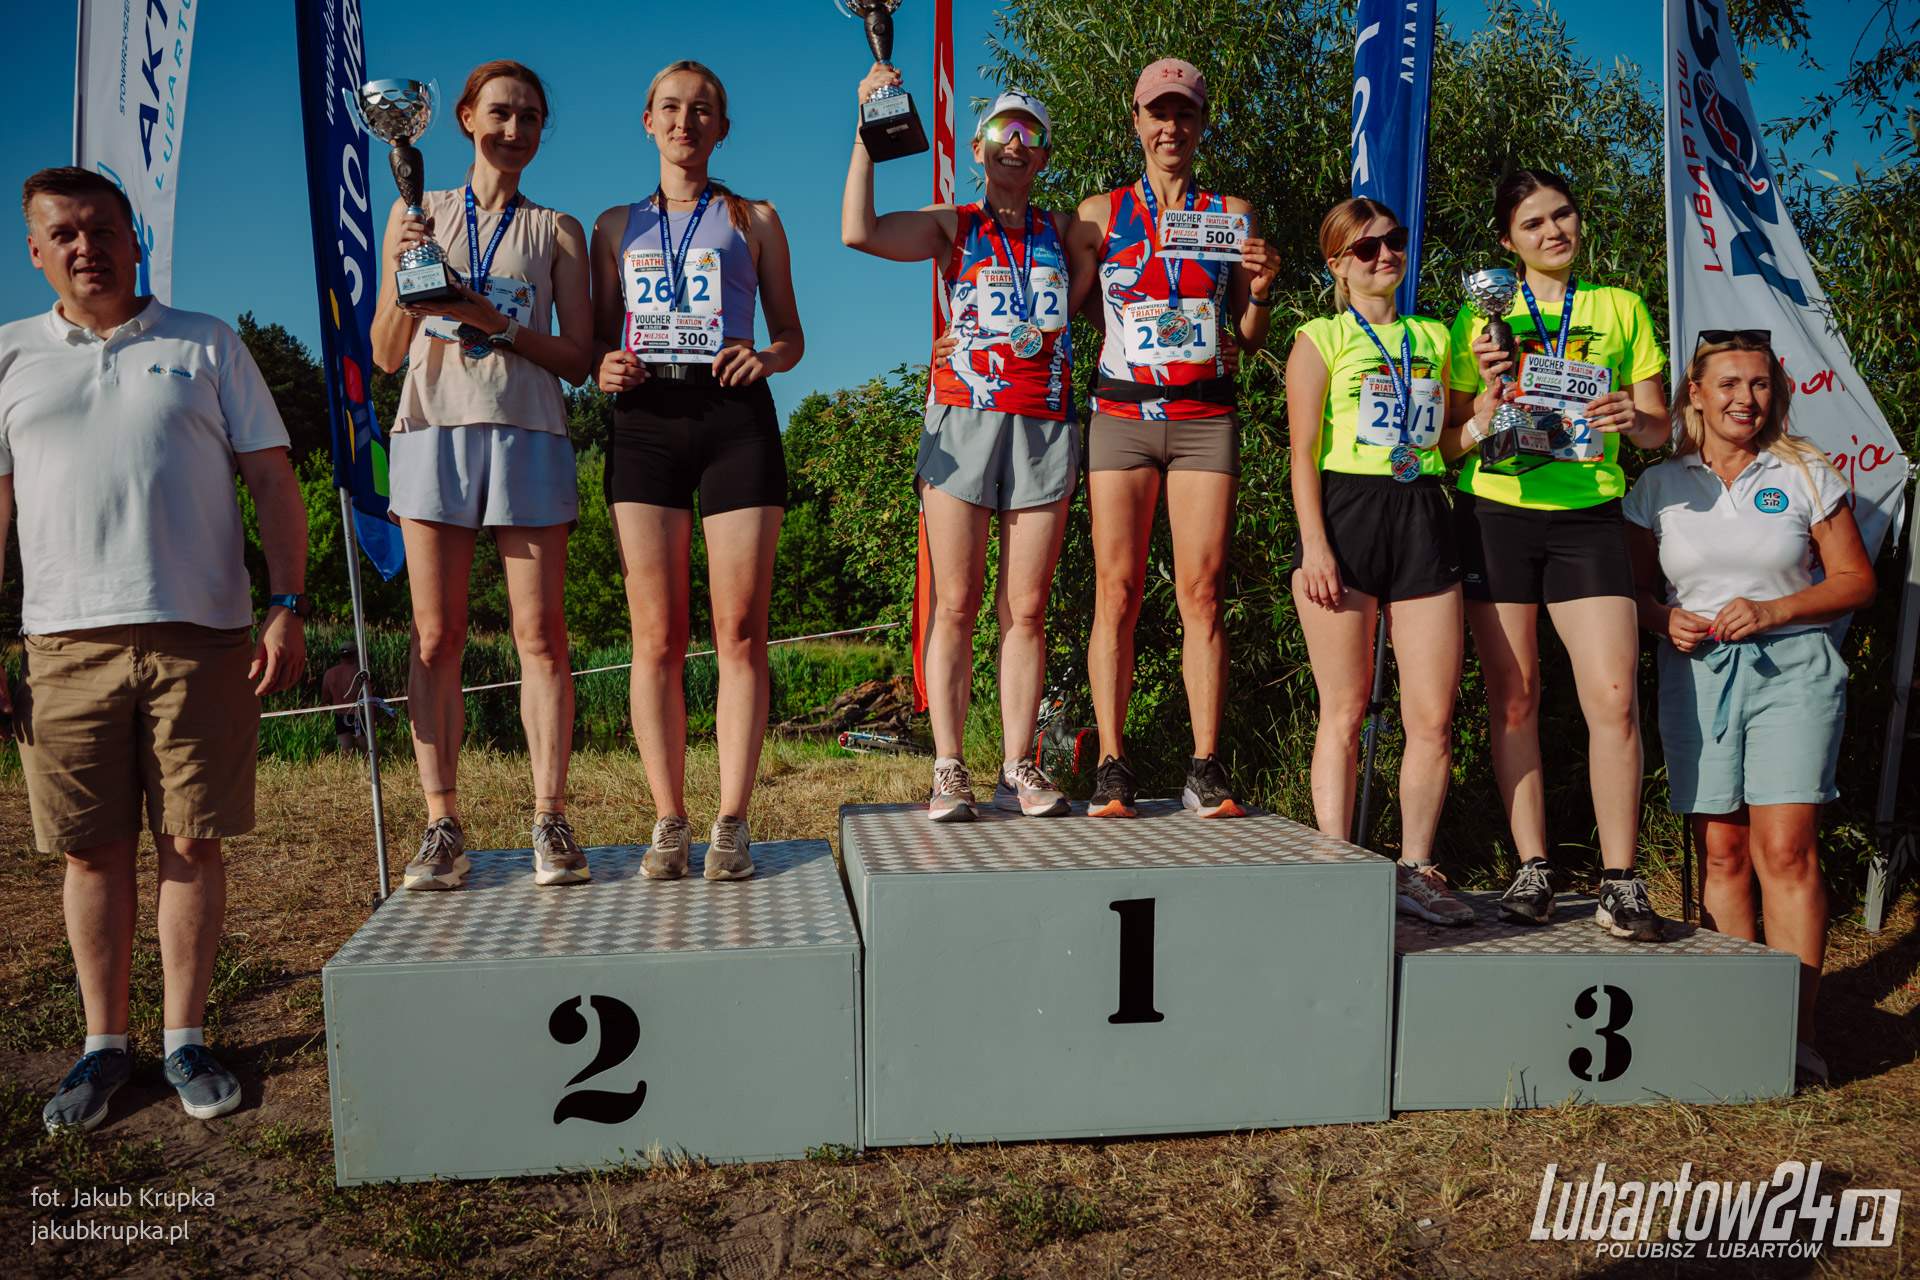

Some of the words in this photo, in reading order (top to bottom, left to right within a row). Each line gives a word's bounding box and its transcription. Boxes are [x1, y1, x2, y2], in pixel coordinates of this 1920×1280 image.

[1165, 211, 1202, 223] VOUCHER
[1165, 228, 1171, 243] 1
[1205, 230, 1235, 245] 500
[634, 314, 671, 325] VOUCHER
[676, 318, 702, 326] TRIATLON
[633, 332, 642, 346] 2
[678, 332, 708, 346] 300
[1529, 356, 1565, 371] VOUCHER
[1568, 365, 1593, 375] TRIATLON
[1523, 372, 1534, 388] 3
[1567, 378, 1597, 397] 200
[1371, 401, 1435, 433] 25/1
[1107, 897, 1165, 1025] 1
[1568, 984, 1633, 1082] 3
[548, 994, 648, 1125] 2
